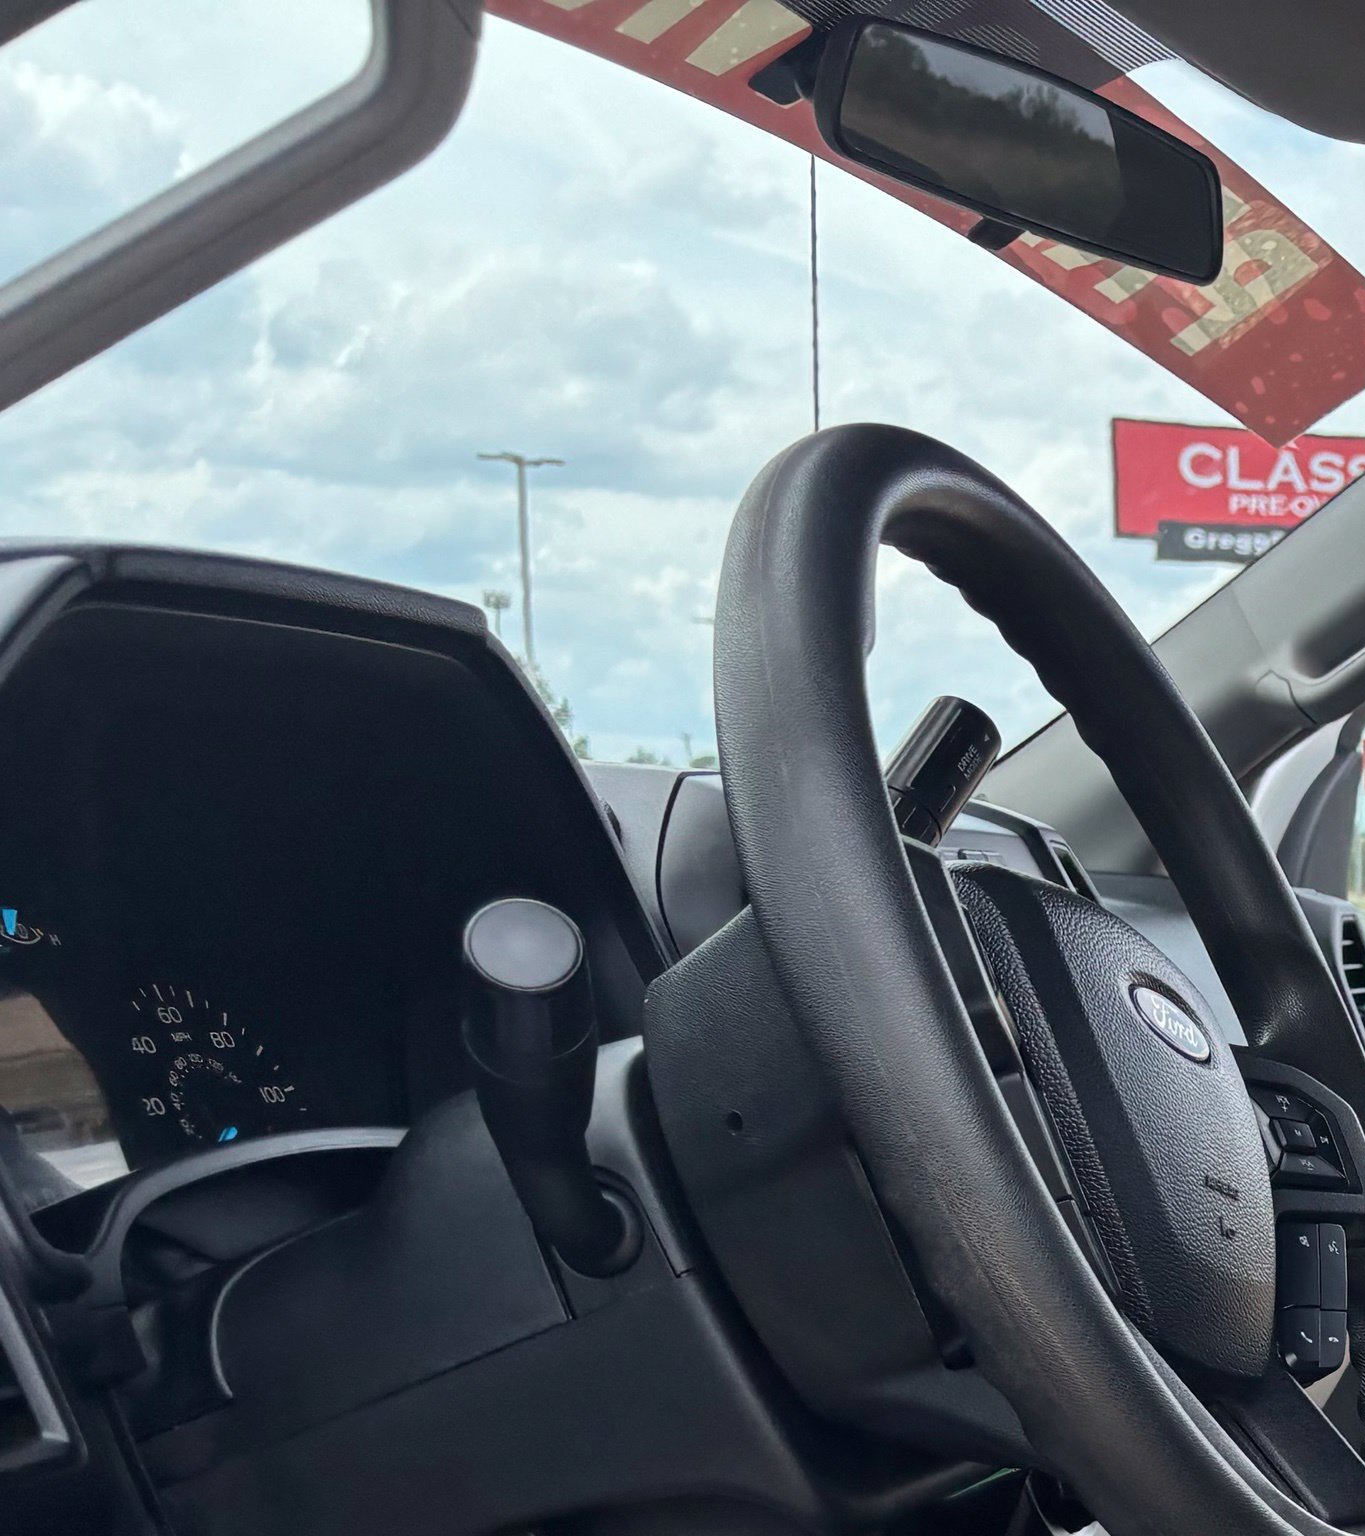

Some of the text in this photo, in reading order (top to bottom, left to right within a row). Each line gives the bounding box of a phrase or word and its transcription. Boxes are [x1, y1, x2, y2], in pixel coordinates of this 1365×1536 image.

[957, 744, 978, 772] DRIVE
[157, 1006, 183, 1024] 60
[1150, 995, 1199, 1048] Ford
[131, 1036, 157, 1054] 40
[209, 1031, 236, 1049] 80
[259, 1086, 286, 1103] 100
[142, 1096, 166, 1116] 20
